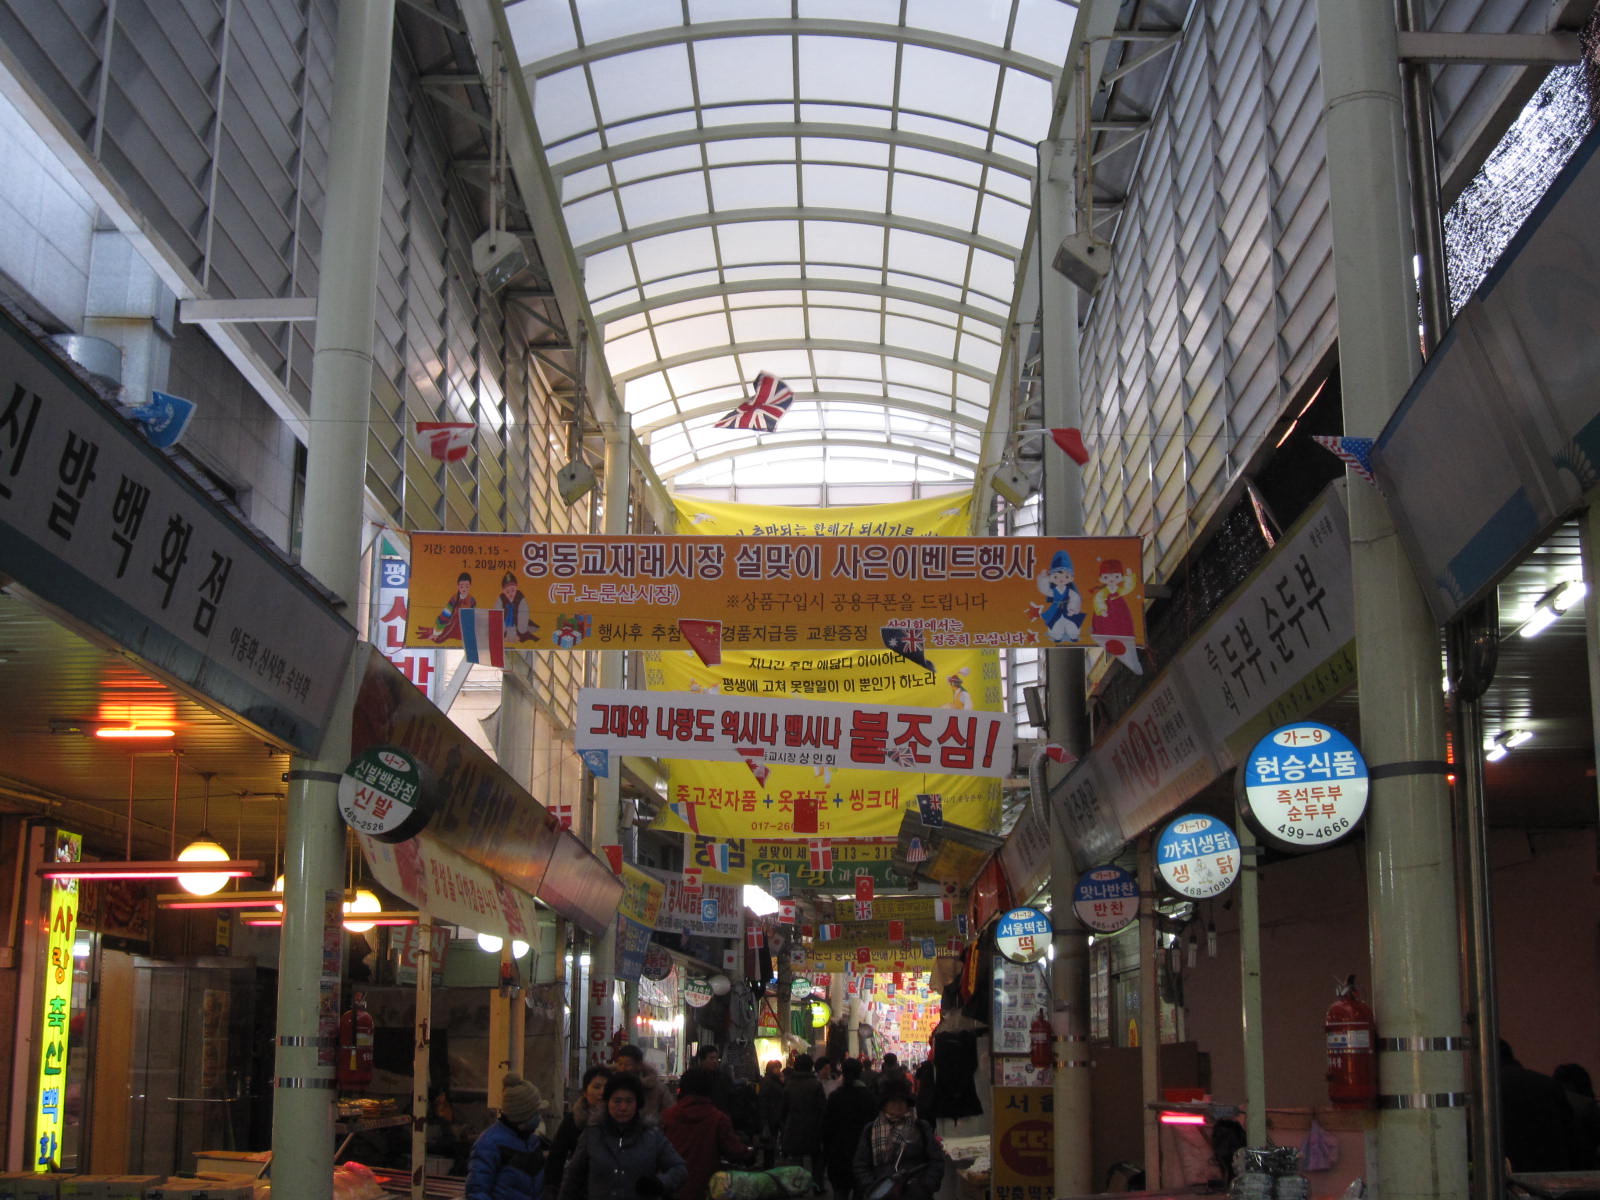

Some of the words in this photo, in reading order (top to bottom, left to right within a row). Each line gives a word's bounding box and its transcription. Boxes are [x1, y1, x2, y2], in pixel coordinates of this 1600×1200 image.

[522, 542, 724, 579] 영동교재래시장
[735, 543, 821, 580] 설맞이
[832, 544, 1035, 581] 사은이벤트행사
[920, 593, 988, 612] 드립니다
[598, 624, 643, 643] 행사후
[721, 625, 798, 643] 경품지급등
[807, 625, 868, 642] 교환증정
[932, 633, 970, 646] 정중히
[973, 633, 1025, 647] 모십니다
[762, 679, 786, 693] 고쳐
[899, 671, 936, 687] 하노라
[590, 703, 649, 739] 그대와
[656, 706, 715, 742] 나랑도
[721, 710, 779, 746] 역시나
[848, 709, 1001, 770] 불조심!
[1283, 729, 1323, 745] 가-9
[1255, 751, 1357, 783] 현승식품
[354, 760, 417, 802] 신발백화점
[353, 787, 393, 820] 신발
[849, 787, 899, 812] 씽크대
[1276, 785, 1342, 805] 즉석두부
[1287, 803, 1336, 822] 순두부
[1180, 820, 1207, 832] 가-10
[1278, 818, 1349, 839] 499-4666
[758, 845, 793, 860] 설맞이
[1164, 831, 1231, 859] 까치생닭
[1172, 864, 1190, 884] 생
[1216, 855, 1234, 875] 닭
[1080, 881, 1134, 899] 맛나반찬
[1184, 877, 1231, 895] 468-1090
[1094, 901, 1124, 917] 반찬
[1002, 920, 1048, 936] 서울떡집
[1018, 935, 1035, 953] 떡
